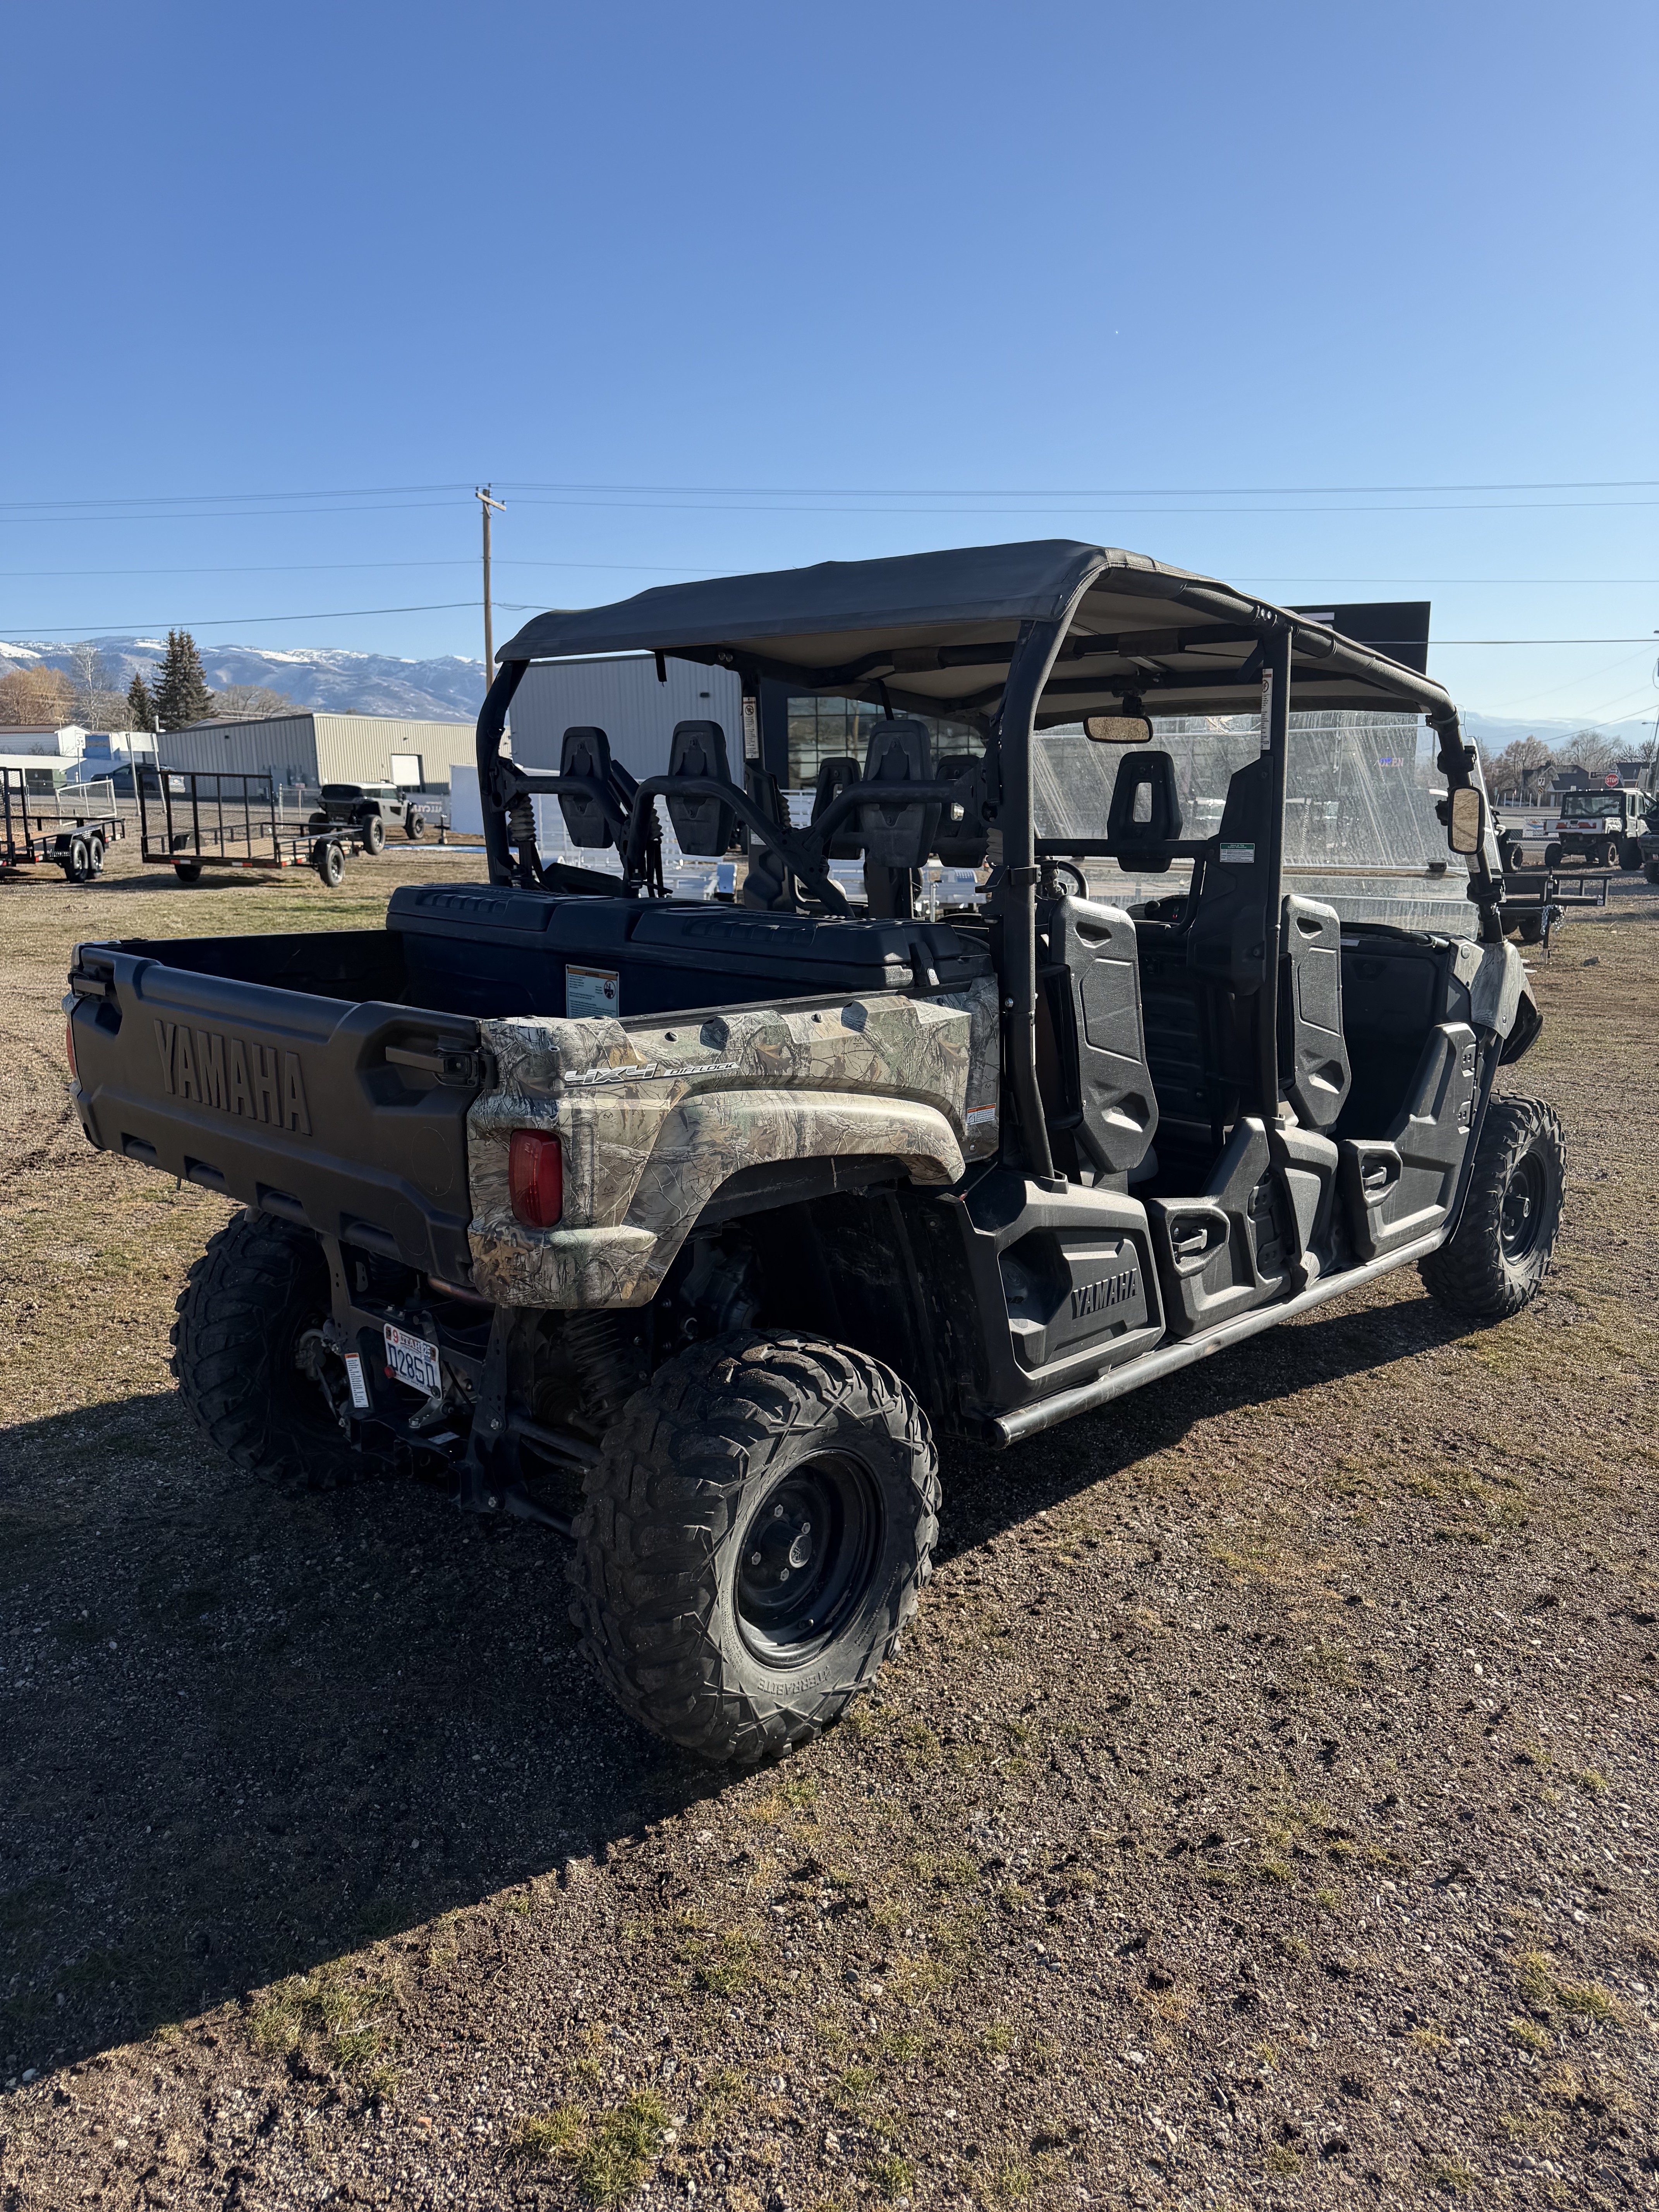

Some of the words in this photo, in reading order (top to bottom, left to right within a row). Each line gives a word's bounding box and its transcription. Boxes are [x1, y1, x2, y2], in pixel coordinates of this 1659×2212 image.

[1379, 757, 1403, 767] OPEN
[153, 1019, 312, 1137] YAMAHA
[670, 1063, 735, 1075] DIFFLOCK
[1072, 1268, 1138, 1319] YAMAHA
[393, 1329, 398, 1343] 9
[401, 1335, 422, 1351] UTAH
[424, 1345, 431, 1357] 25
